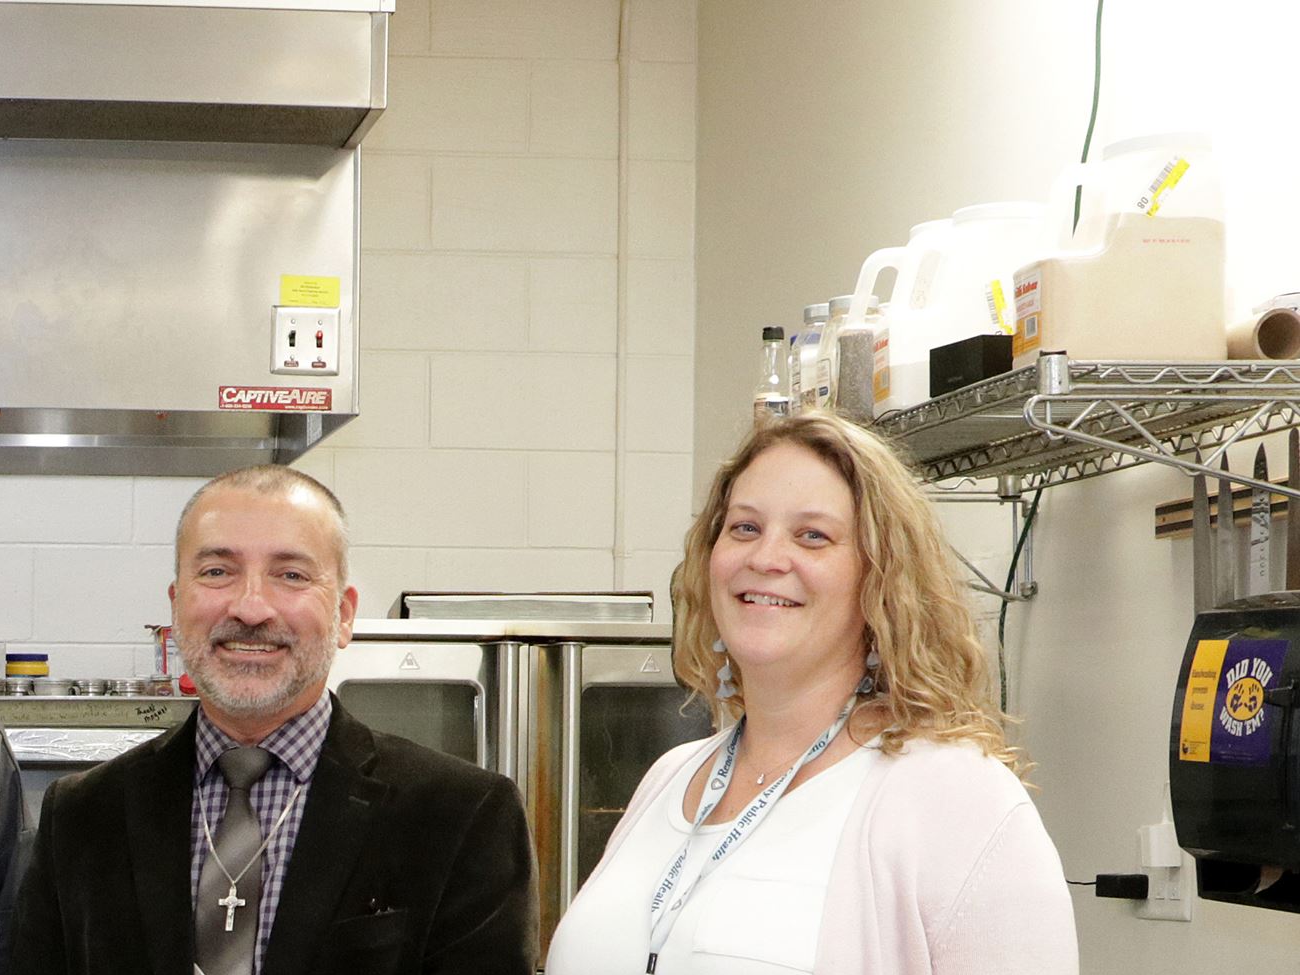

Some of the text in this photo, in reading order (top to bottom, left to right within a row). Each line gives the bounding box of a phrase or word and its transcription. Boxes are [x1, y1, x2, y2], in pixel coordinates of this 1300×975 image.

[1226, 657, 1273, 689] DID YOU
[1219, 706, 1243, 737] WASH
[717, 754, 733, 778] Reno
[737, 798, 768, 829] Public
[712, 827, 742, 861] Health
[651, 877, 674, 913] Health
